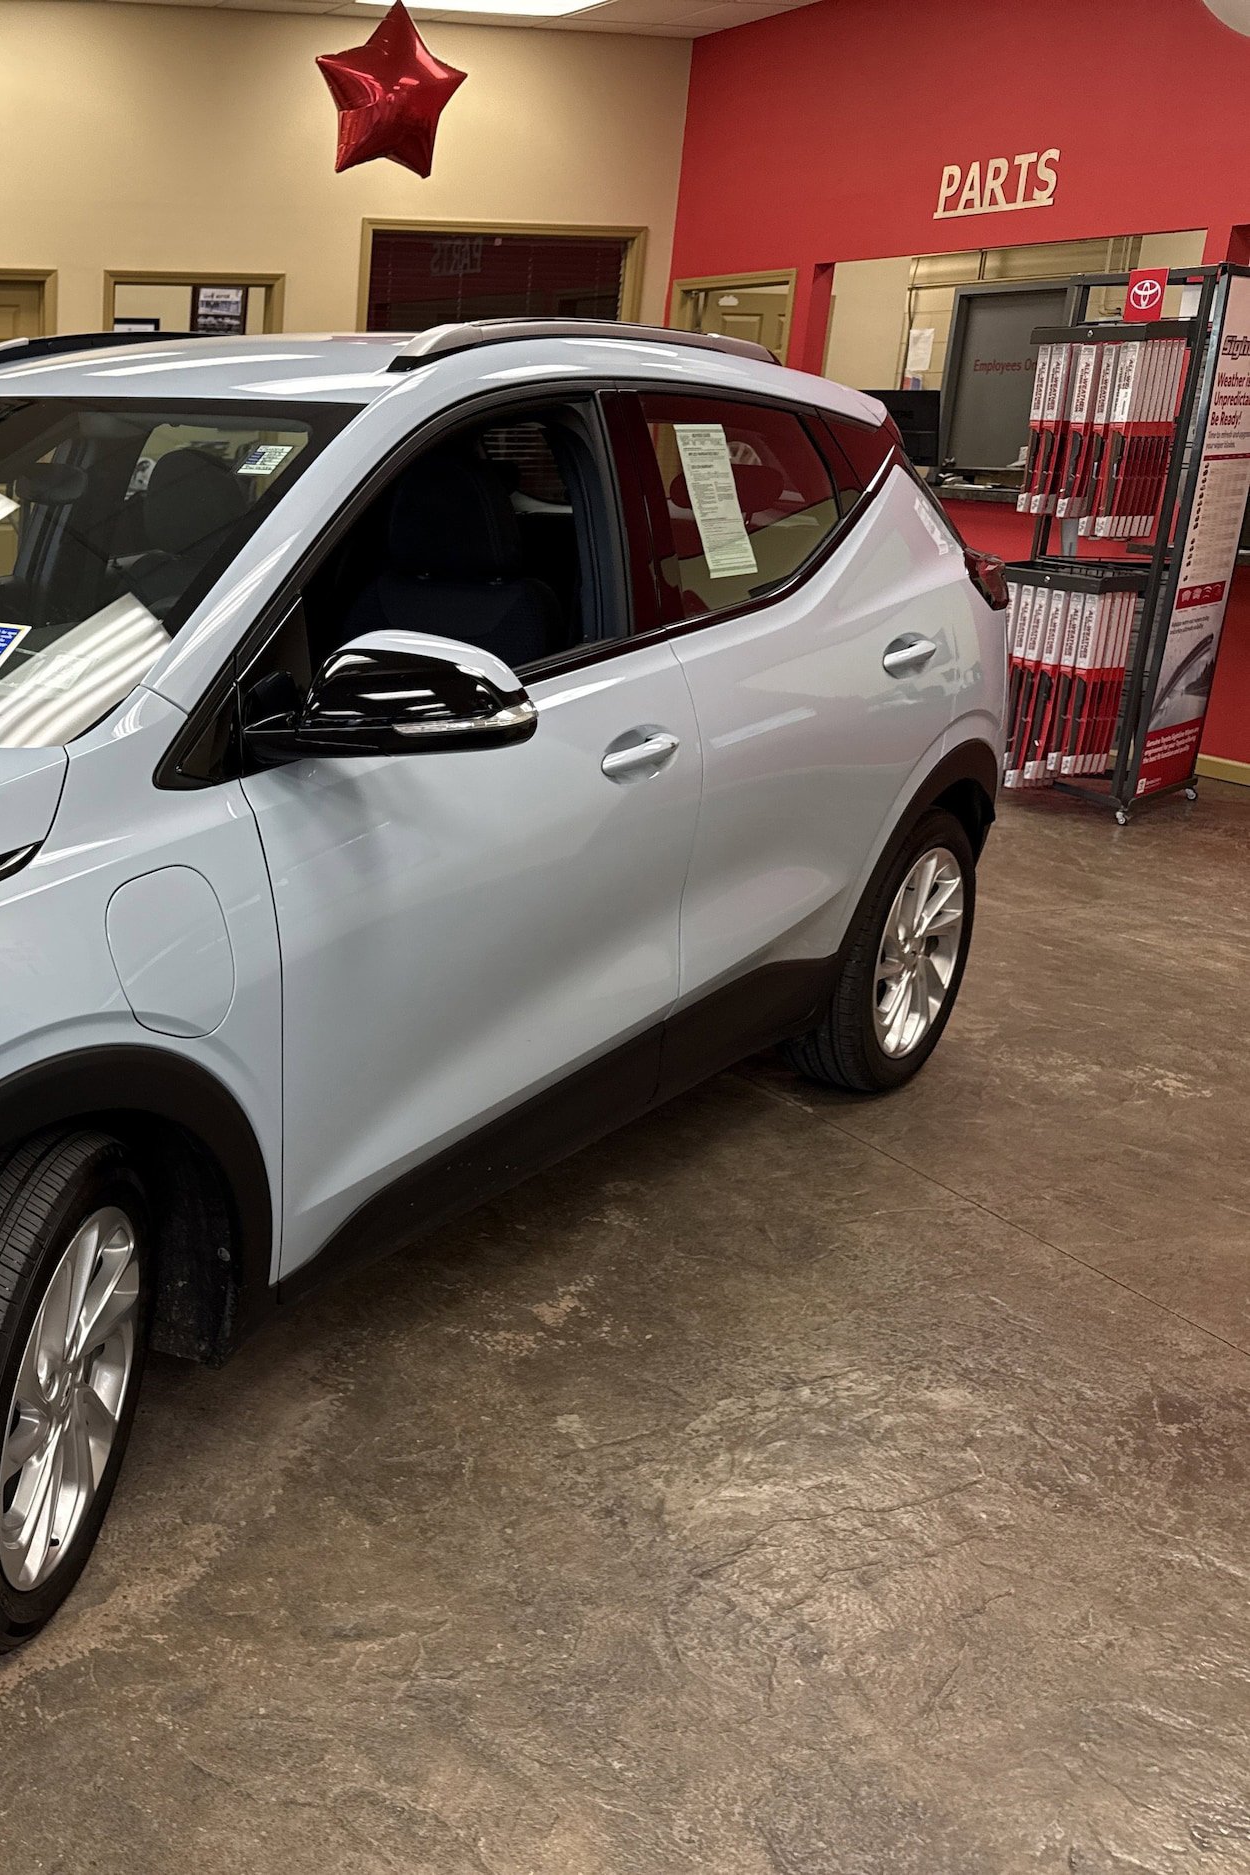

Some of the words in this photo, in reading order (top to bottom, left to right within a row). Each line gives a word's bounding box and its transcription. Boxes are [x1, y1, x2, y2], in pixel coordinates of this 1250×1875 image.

[936, 148, 1060, 214] PARTS
[973, 359, 1022, 374] Employees
[1217, 372, 1246, 388] Weather
[1050, 361, 1061, 410] ALL-WEATHER
[1078, 361, 1091, 413] ALL-WEATHER
[1211, 411, 1220, 426] Be
[1221, 411, 1242, 429] Ready!
